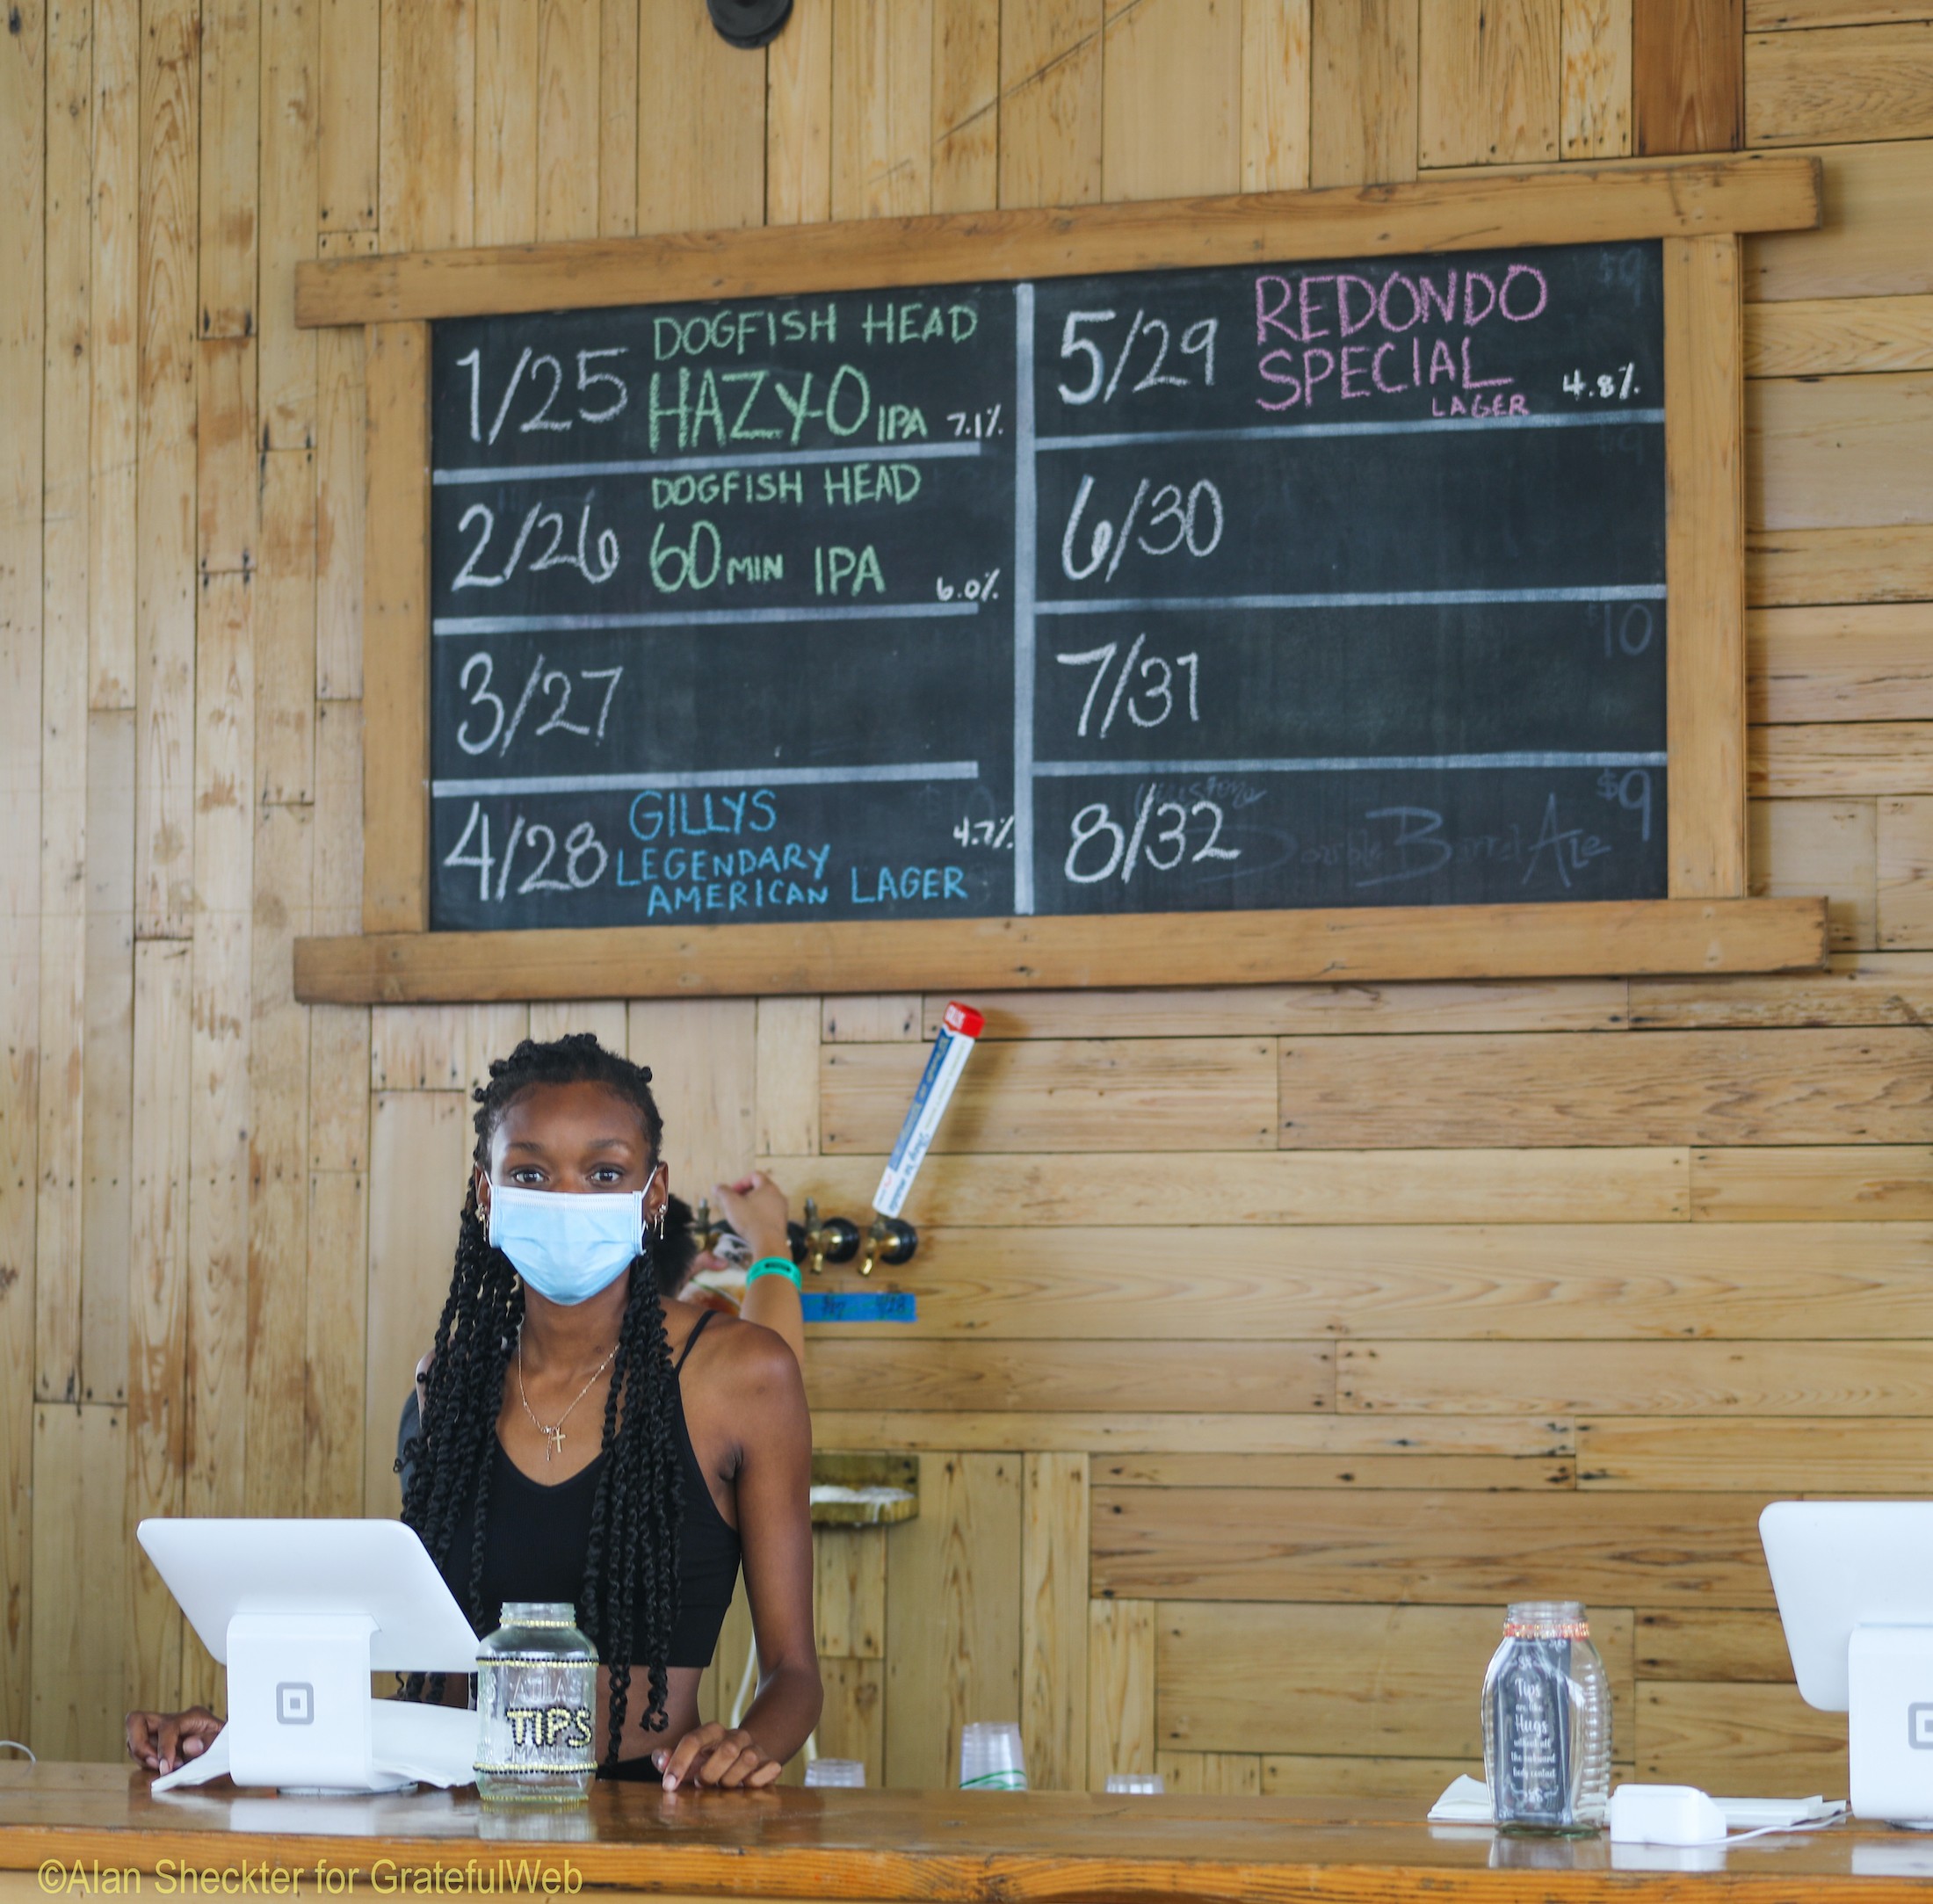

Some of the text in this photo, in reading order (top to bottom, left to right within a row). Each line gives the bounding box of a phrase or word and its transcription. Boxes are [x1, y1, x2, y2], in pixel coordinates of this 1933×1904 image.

[653, 303, 977, 360] DOGFISH HEAD
[1256, 264, 1547, 344] REDONDO
[1058, 309, 1218, 405] 5/29
[1256, 337, 1512, 411] SPECIAL
[1432, 362, 1640, 416] LAGER 4.8%
[457, 347, 627, 445] 1/25
[878, 405, 927, 442] IPA
[947, 404, 1003, 437] 7.1%
[652, 463, 921, 510] DOGFISH HEAD
[452, 501, 619, 591] 2/26
[1061, 474, 1223, 582] 6/30
[649, 521, 1000, 601] 60 MIN IPA 6.0%
[457, 652, 623, 757] 3/27
[1056, 633, 1198, 738] 7/31
[629, 790, 776, 841] GILLYS
[953, 815, 1013, 849] 4.7%
[1064, 784, 1241, 884] 8/32
[444, 801, 608, 902] 4/28
[617, 843, 830, 887] LEGENDARY
[648, 866, 967, 917] AMERICAN LAGER
[1514, 1677, 1541, 1703] Tips
[504, 1706, 592, 1748] TIPS
[1515, 1713, 1547, 1738] Hugs
